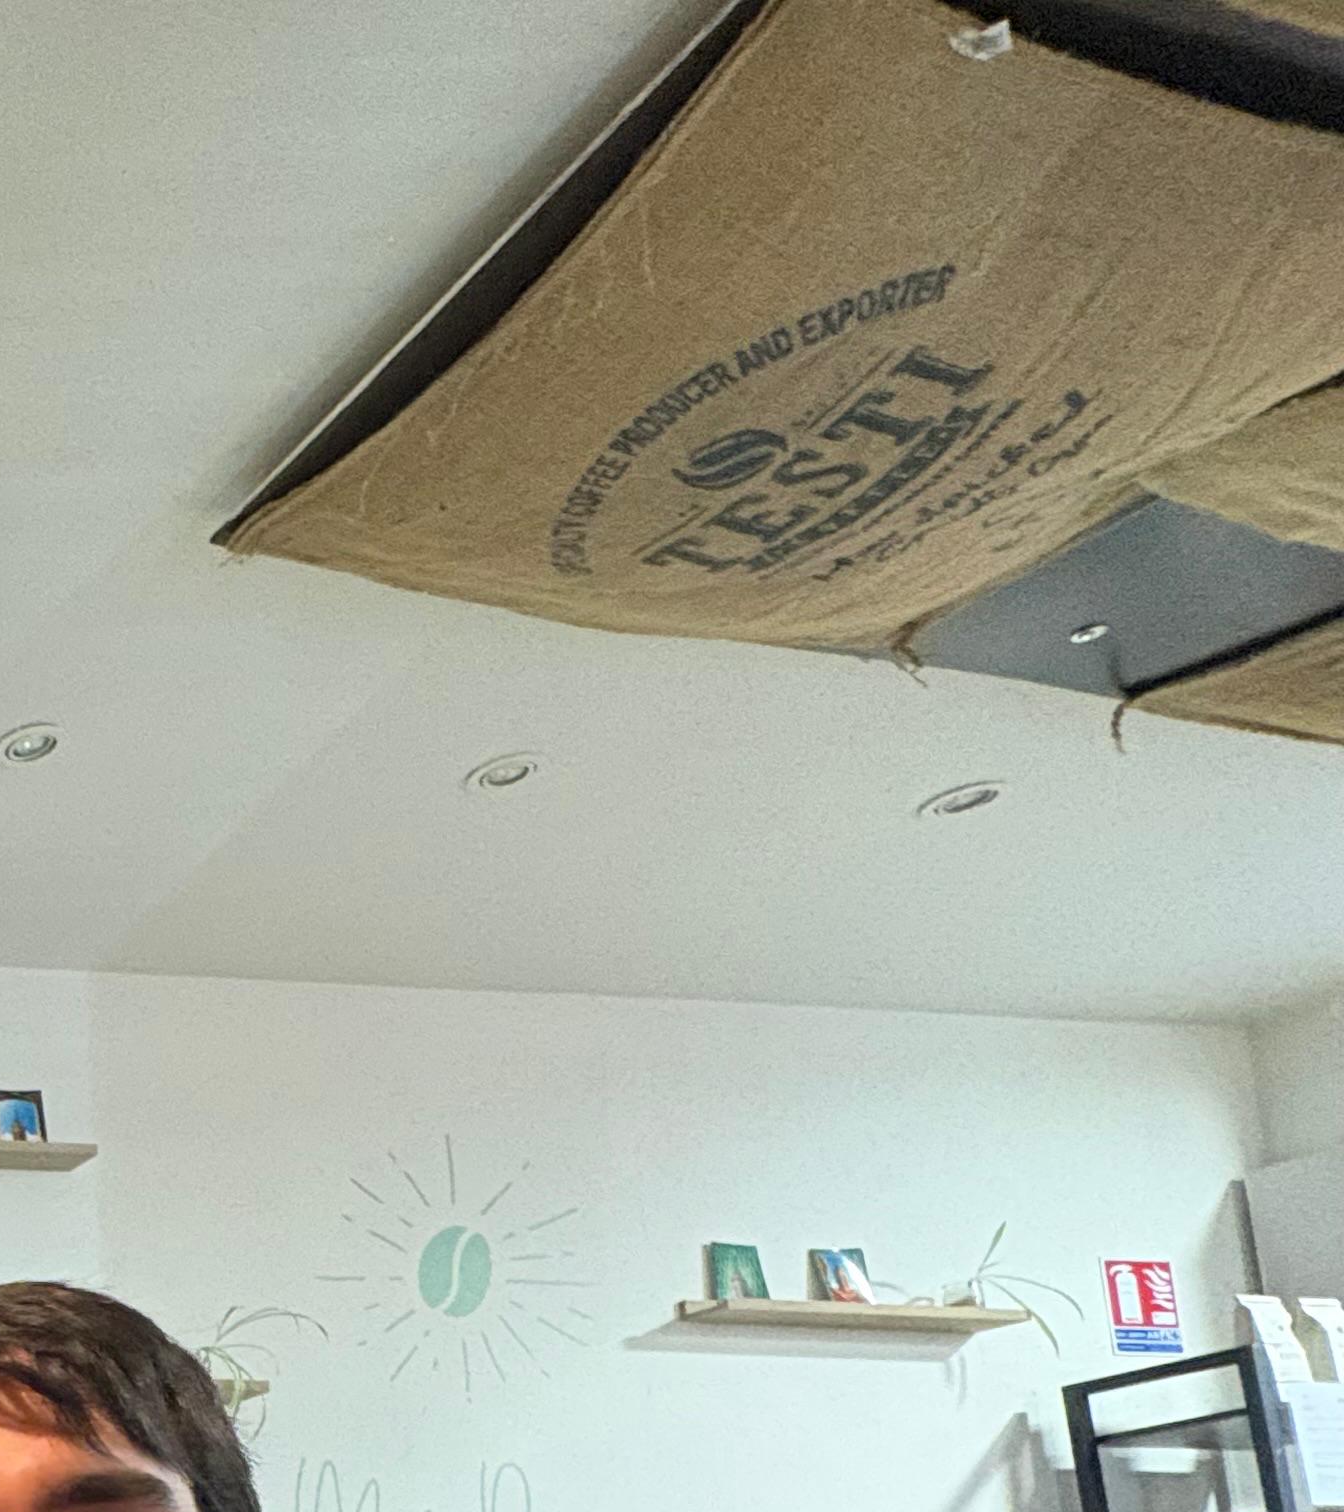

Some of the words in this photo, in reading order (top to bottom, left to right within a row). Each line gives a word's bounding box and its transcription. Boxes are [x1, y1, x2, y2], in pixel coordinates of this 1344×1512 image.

[608, 361, 740, 457] PRODUCER
[734, 326, 795, 379] AND
[641, 345, 996, 573] TESTI
